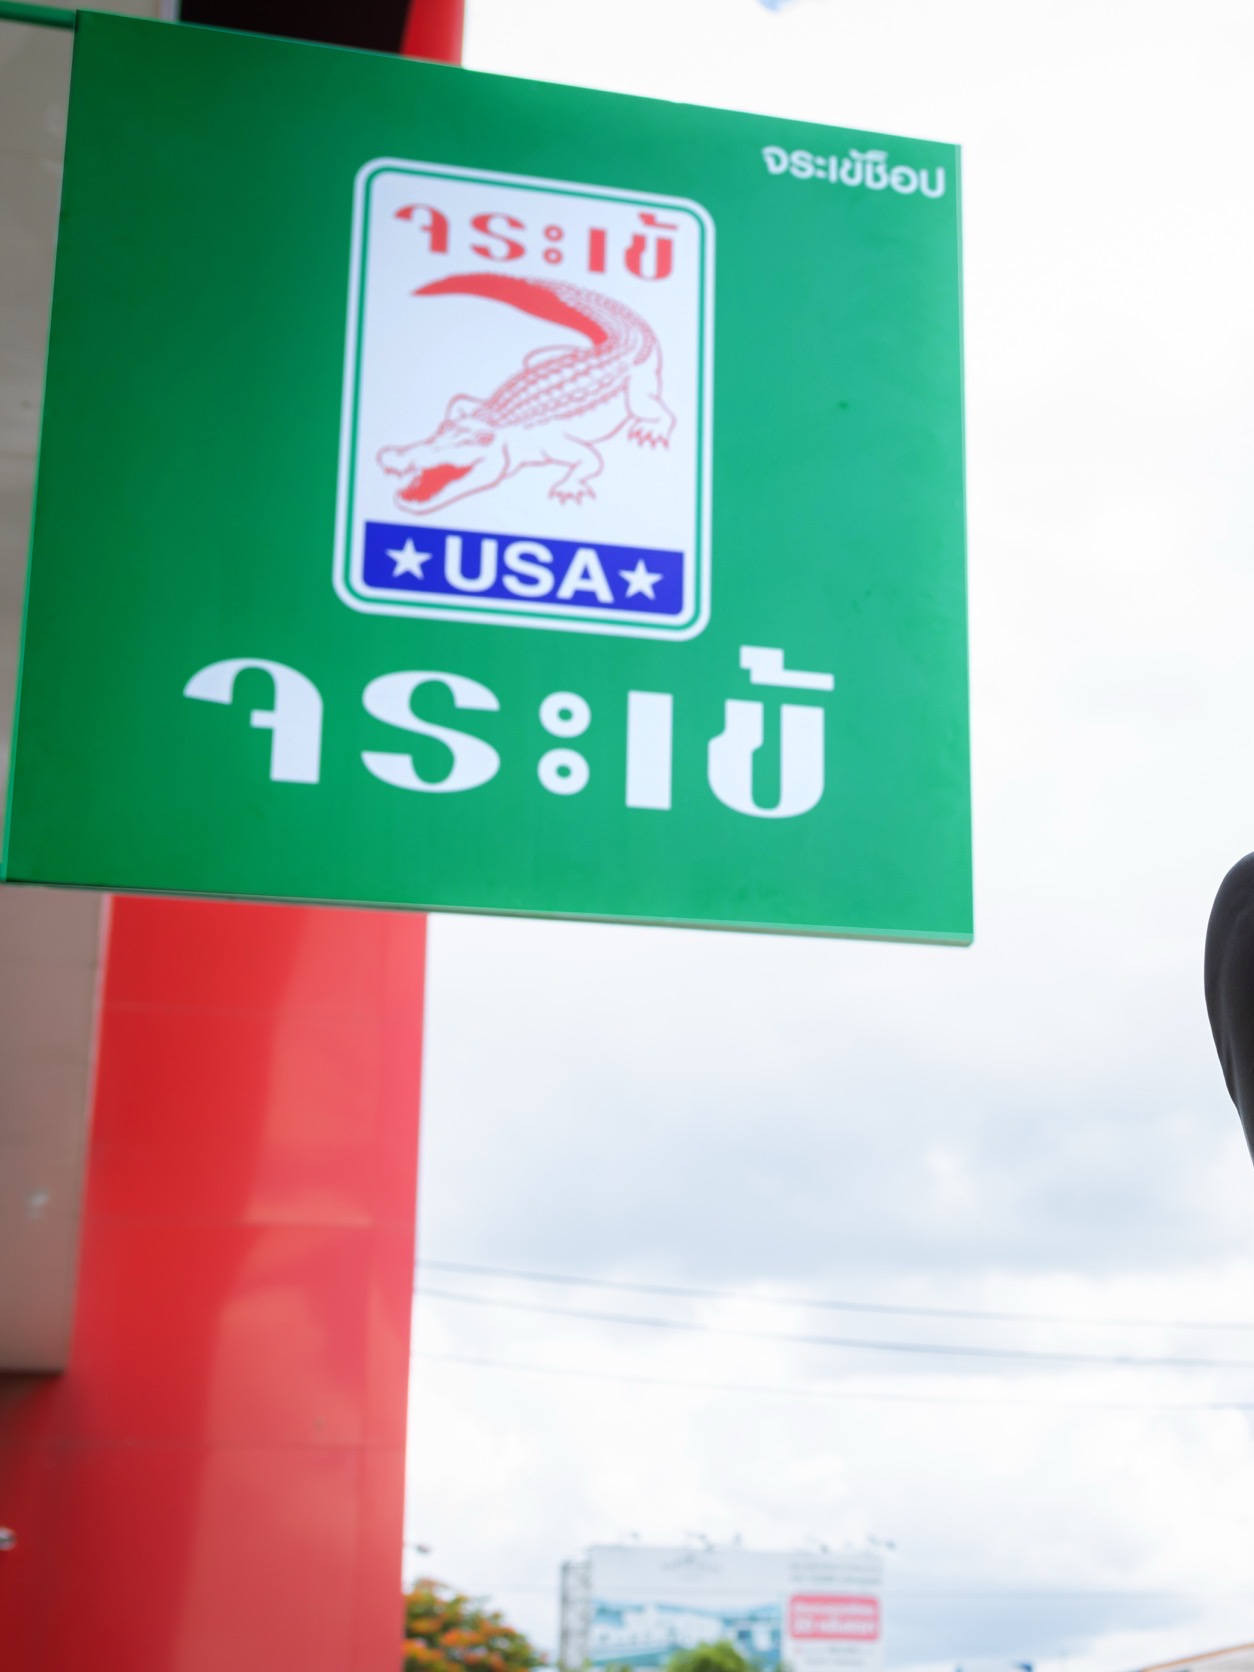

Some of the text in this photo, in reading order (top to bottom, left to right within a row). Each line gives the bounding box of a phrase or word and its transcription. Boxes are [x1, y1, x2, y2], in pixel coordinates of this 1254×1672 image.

[394, 204, 678, 282] จระเข้
[443, 535, 615, 604] USA
[183, 646, 835, 819] จระเข้
